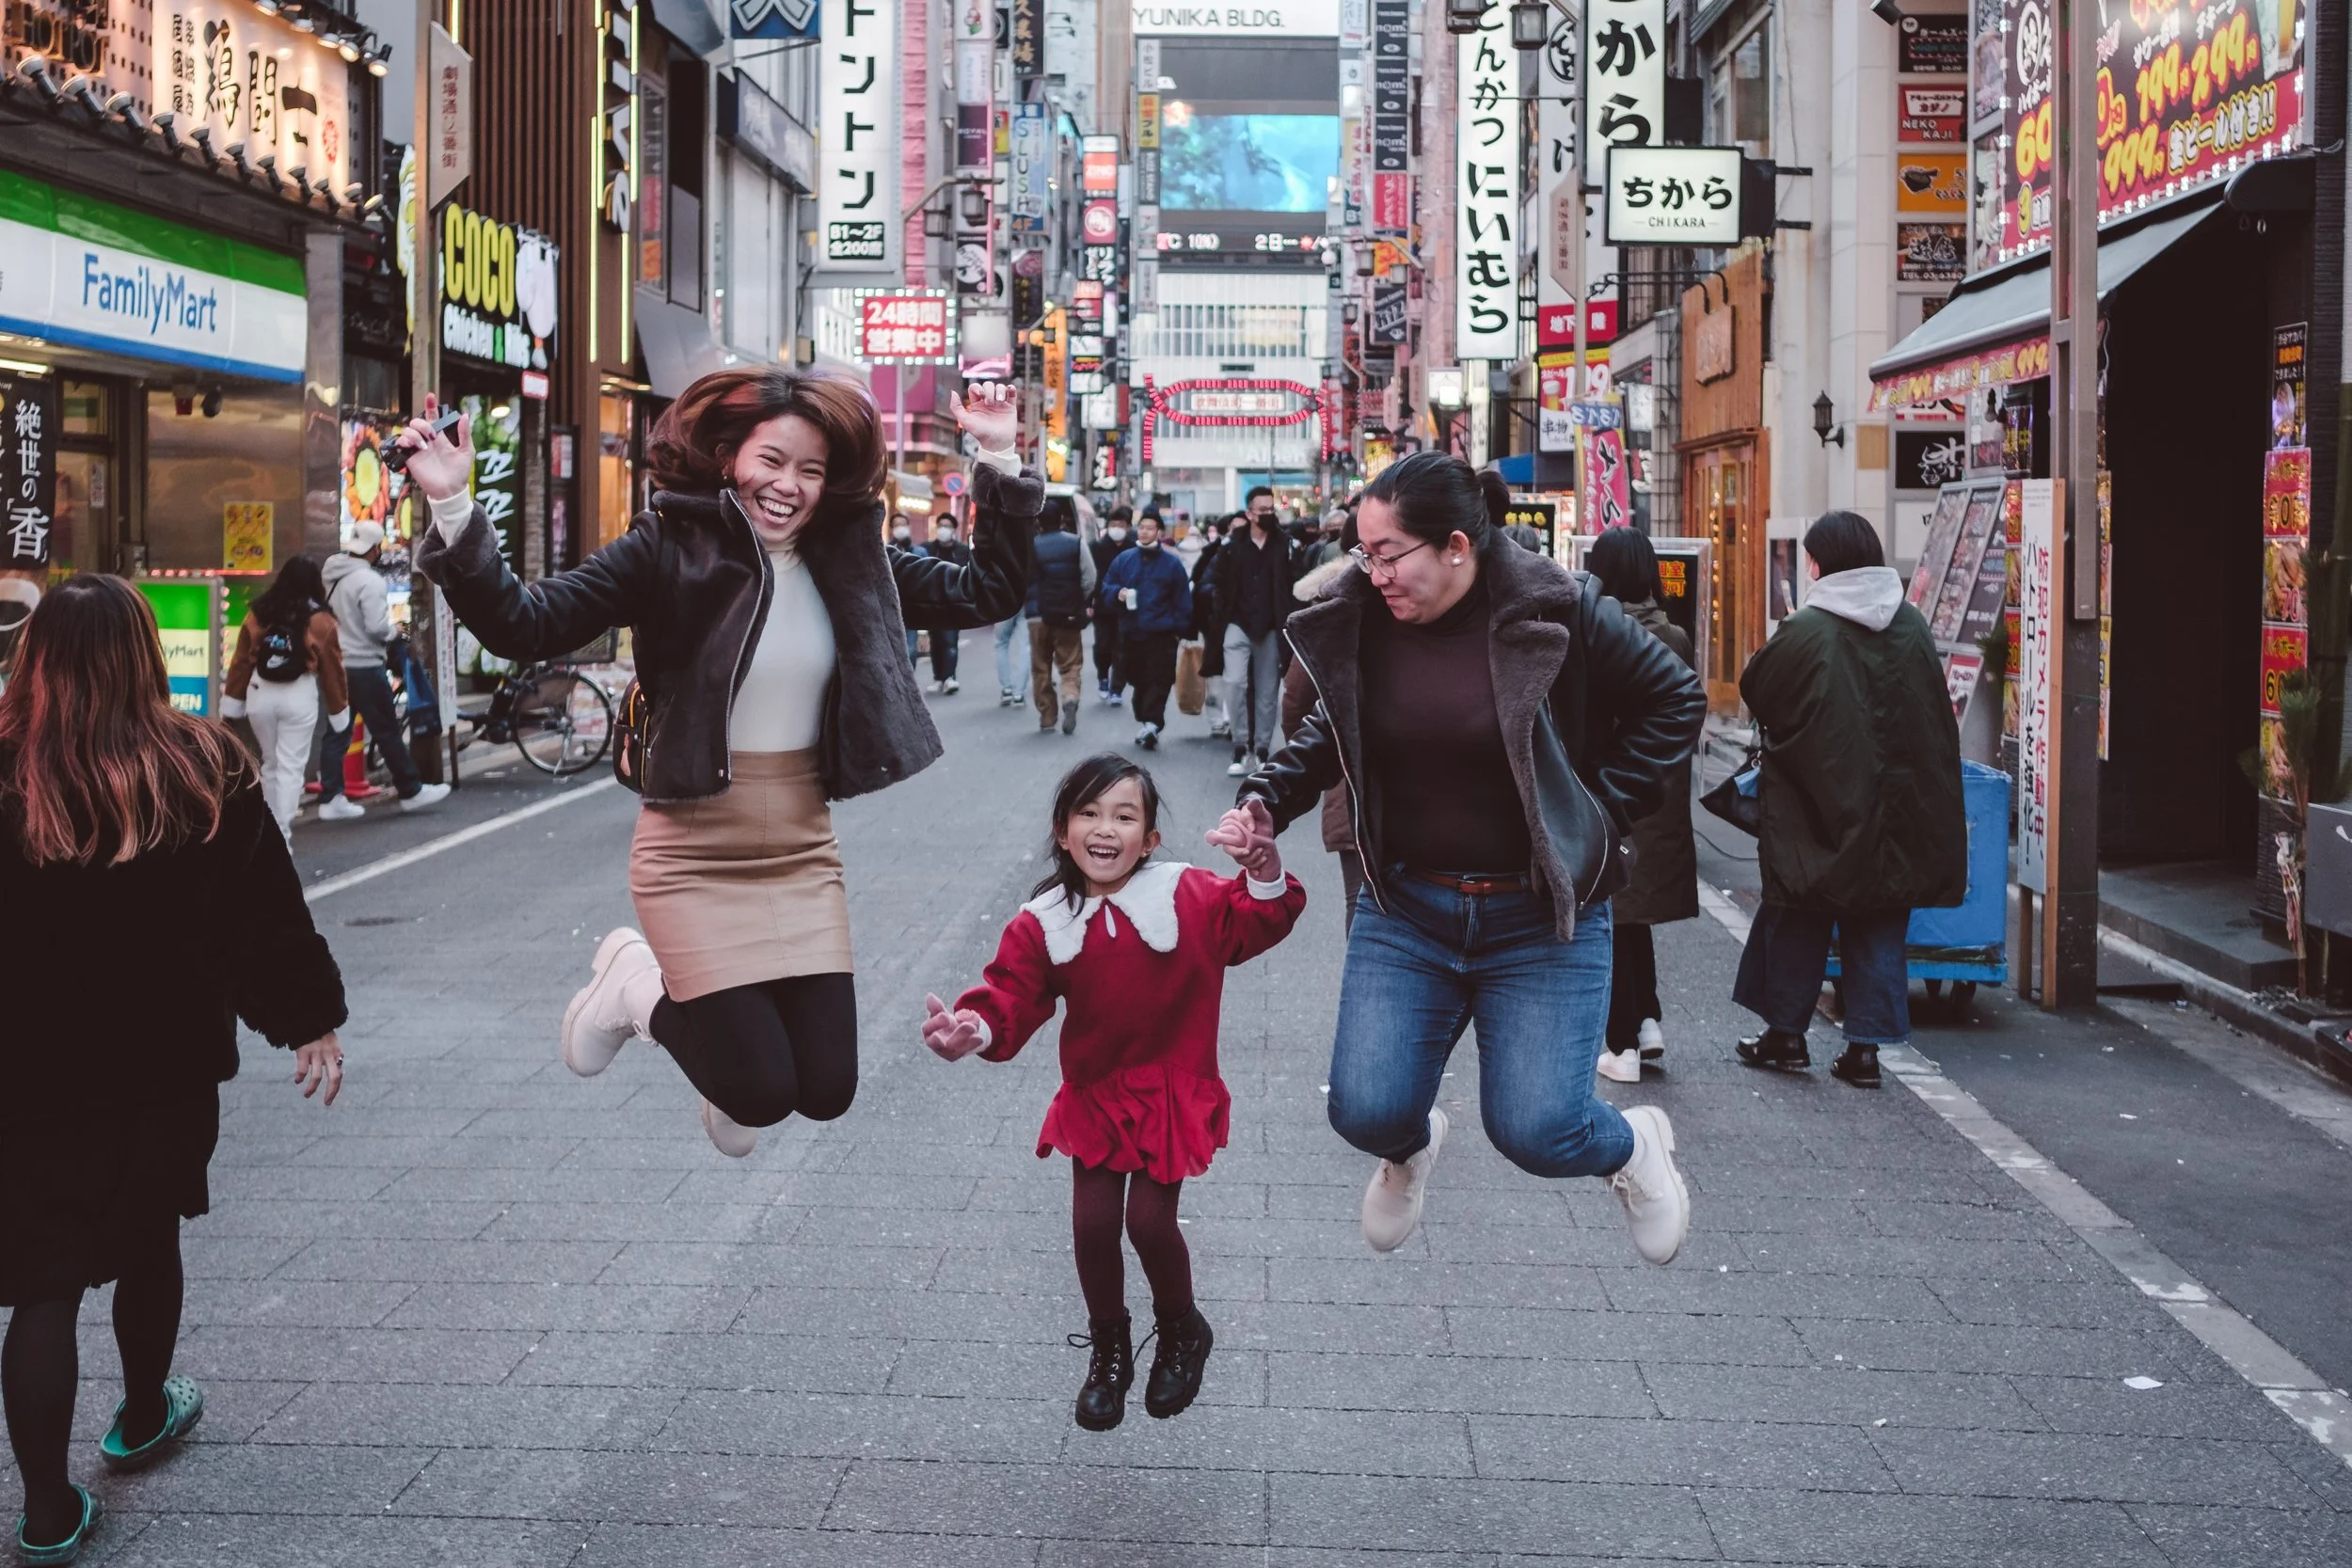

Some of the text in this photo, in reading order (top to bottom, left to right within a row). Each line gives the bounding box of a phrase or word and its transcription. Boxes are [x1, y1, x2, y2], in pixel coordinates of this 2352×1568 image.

[1132, 8, 1286, 27] YUNIKA BLDG.
[1596, 0, 1656, 147] から
[1902, 119, 1937, 130] NEKO
[1923, 130, 1953, 139] KAJI
[1017, 121, 1029, 213] SLUSH
[1622, 176, 1734, 211] ちから
[1012, 217, 1033, 230] 4F
[1648, 216, 1707, 229] CHIKARA
[445, 202, 516, 318] COCO
[82, 253, 217, 335] FamilyMart
[866, 301, 942, 326] 24時間
[866, 328, 942, 354] 営業中
[163, 643, 205, 661] lyMart
[168, 693, 202, 711] PEN
